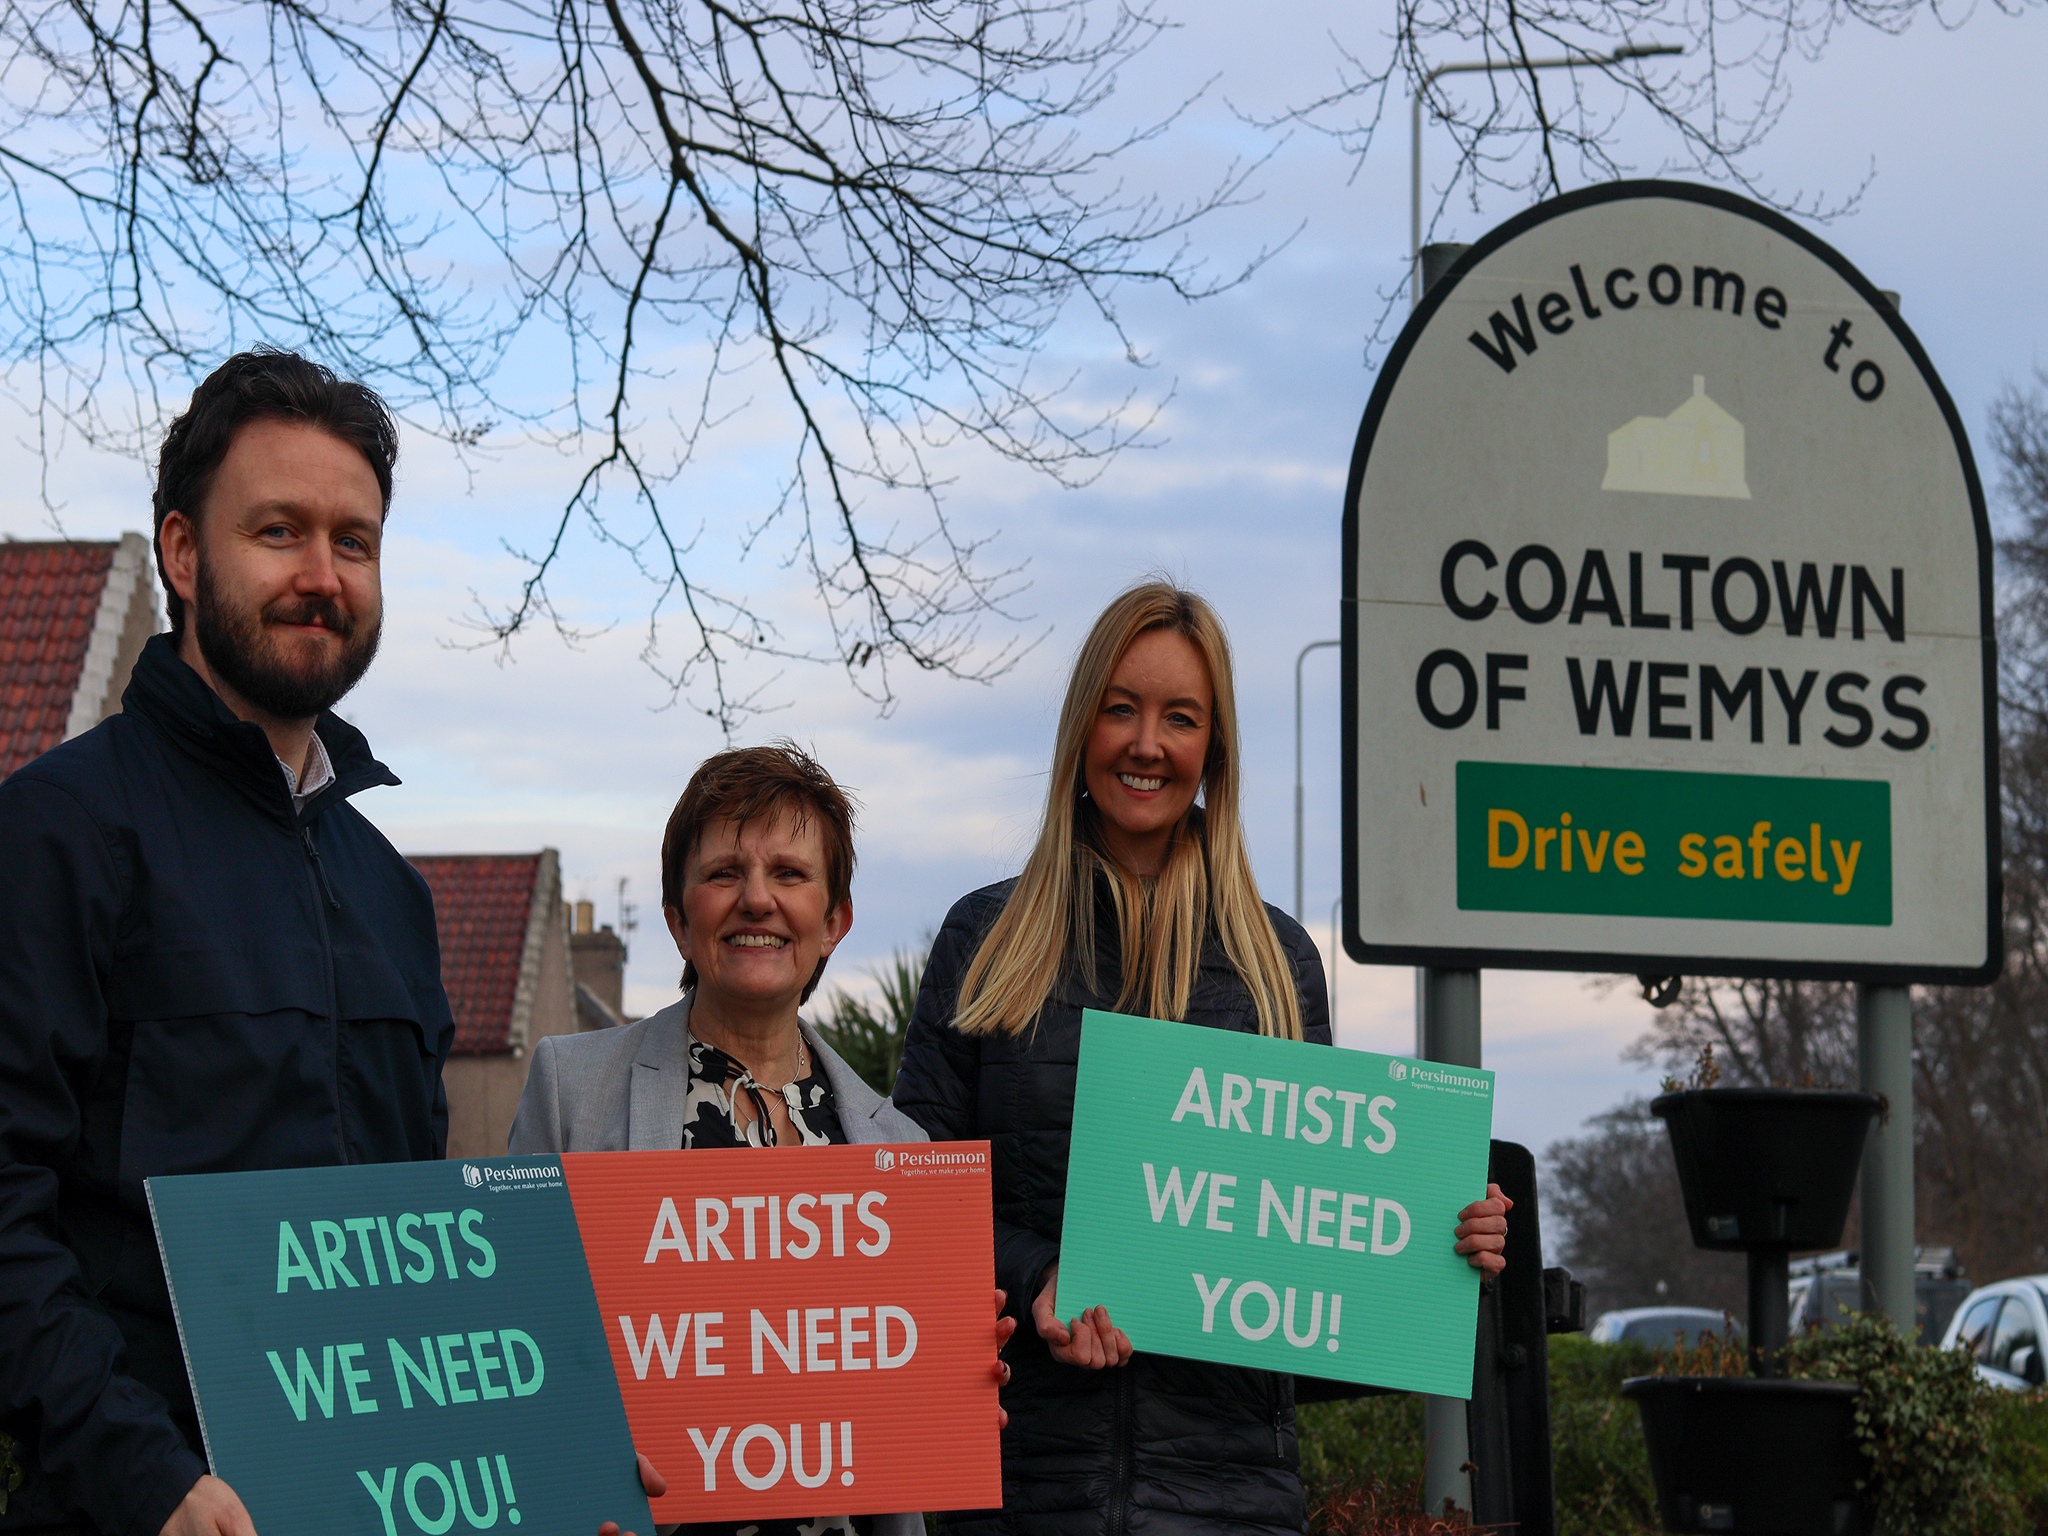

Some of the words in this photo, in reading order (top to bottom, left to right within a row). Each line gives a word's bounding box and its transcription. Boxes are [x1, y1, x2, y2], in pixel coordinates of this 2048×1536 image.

[1468, 263, 1789, 374] Welcome
[1822, 318, 1886, 403] to
[1440, 539, 1906, 643] COALTOWN
[1415, 648, 1529, 731] OF
[1565, 657, 1931, 752] WEMYSS
[1487, 808, 1646, 876] Drive
[1678, 821, 1862, 895] safely
[1170, 1067, 1397, 1154] ARTISTS
[1411, 1067, 1489, 1090] Persimmon
[1411, 1081, 1436, 1091] Together,
[1445, 1086, 1460, 1094] make
[1460, 1089, 1473, 1098] your
[484, 1164, 560, 1182] Persimmon
[488, 1184, 513, 1193] Together,
[536, 1182, 548, 1190] your
[900, 1149, 986, 1166] Persimmon
[901, 1168, 928, 1177] Together,
[955, 1167, 968, 1175] your
[643, 1191, 891, 1264] ARTISTS
[1142, 1162, 1237, 1233] WE
[1257, 1178, 1411, 1256] NEED
[276, 1208, 497, 1293] ARTISTS
[618, 1311, 725, 1380] WE
[750, 1305, 918, 1375] NEED
[1191, 1273, 1342, 1353] YOU!
[265, 1342, 379, 1422] WE
[387, 1328, 545, 1409] NEED
[356, 1454, 522, 1536] YOU!
[686, 1421, 855, 1492] YOU!
